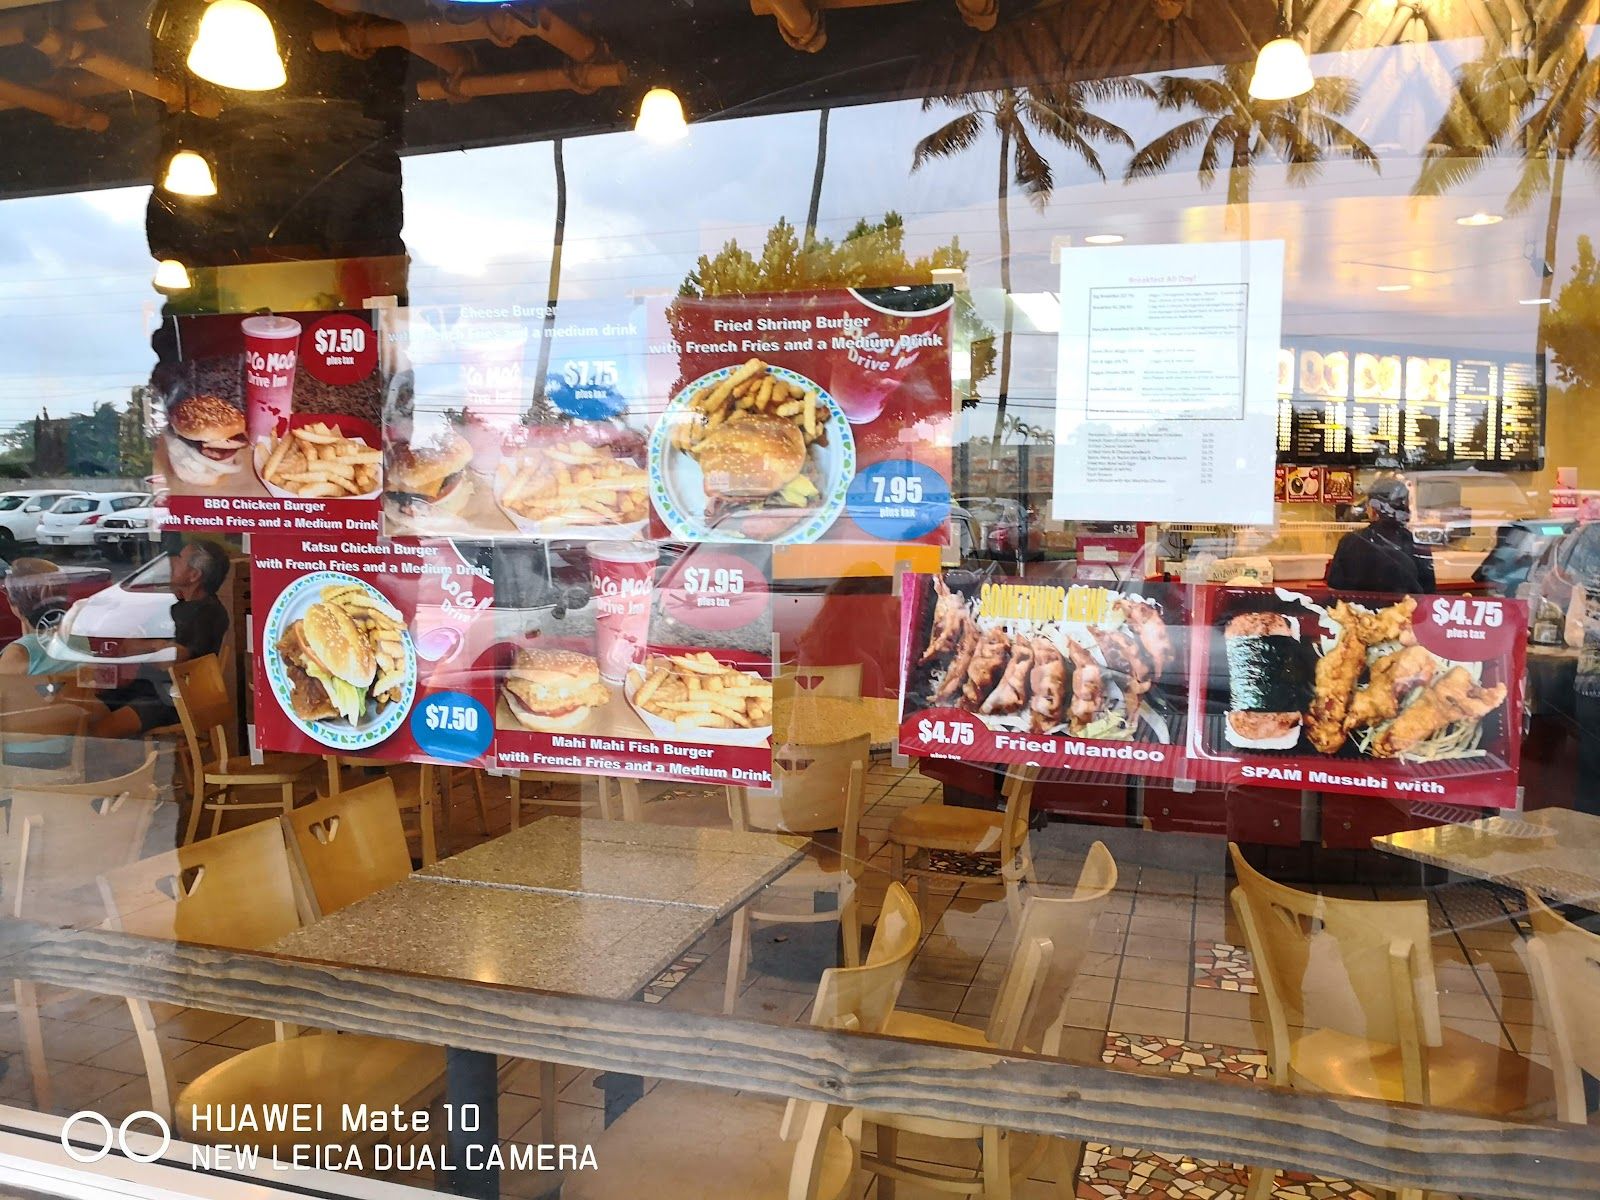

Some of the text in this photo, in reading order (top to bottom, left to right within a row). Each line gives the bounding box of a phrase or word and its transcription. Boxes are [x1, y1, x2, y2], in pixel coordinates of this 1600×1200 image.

[460, 304, 559, 319] Cheese Burger
[714, 316, 871, 332] Fried Shrimp Burger
[315, 328, 366, 355] $7.50
[544, 325, 598, 338] medium
[602, 323, 637, 336] drink
[649, 334, 943, 354] with French Fries and a Medium Drink
[564, 359, 619, 388] $7.75
[872, 476, 923, 504] 7.95
[203, 499, 326, 513] BBQ Chicken Burger
[157, 515, 379, 531] with French Fries and a Medium Drink
[301, 541, 439, 557] Katsu Chicken Burger
[256, 558, 491, 576] with French Fries and a Medium Drink
[684, 567, 744, 595] $7.95
[716, 597, 731, 607] tax
[979, 583, 1066, 621] SOMETHING
[1432, 597, 1503, 627] $4.75
[1445, 628, 1486, 640] plus tax
[426, 703, 479, 731] $7.50
[918, 719, 974, 745] $4.75
[552, 735, 714, 759] Mahi Mahi Fish Burger
[995, 735, 1165, 762] Fried Mandoo
[498, 750, 772, 782] with French Fries and a Medium Drink
[1241, 765, 1446, 795] SPAM Musubi with
